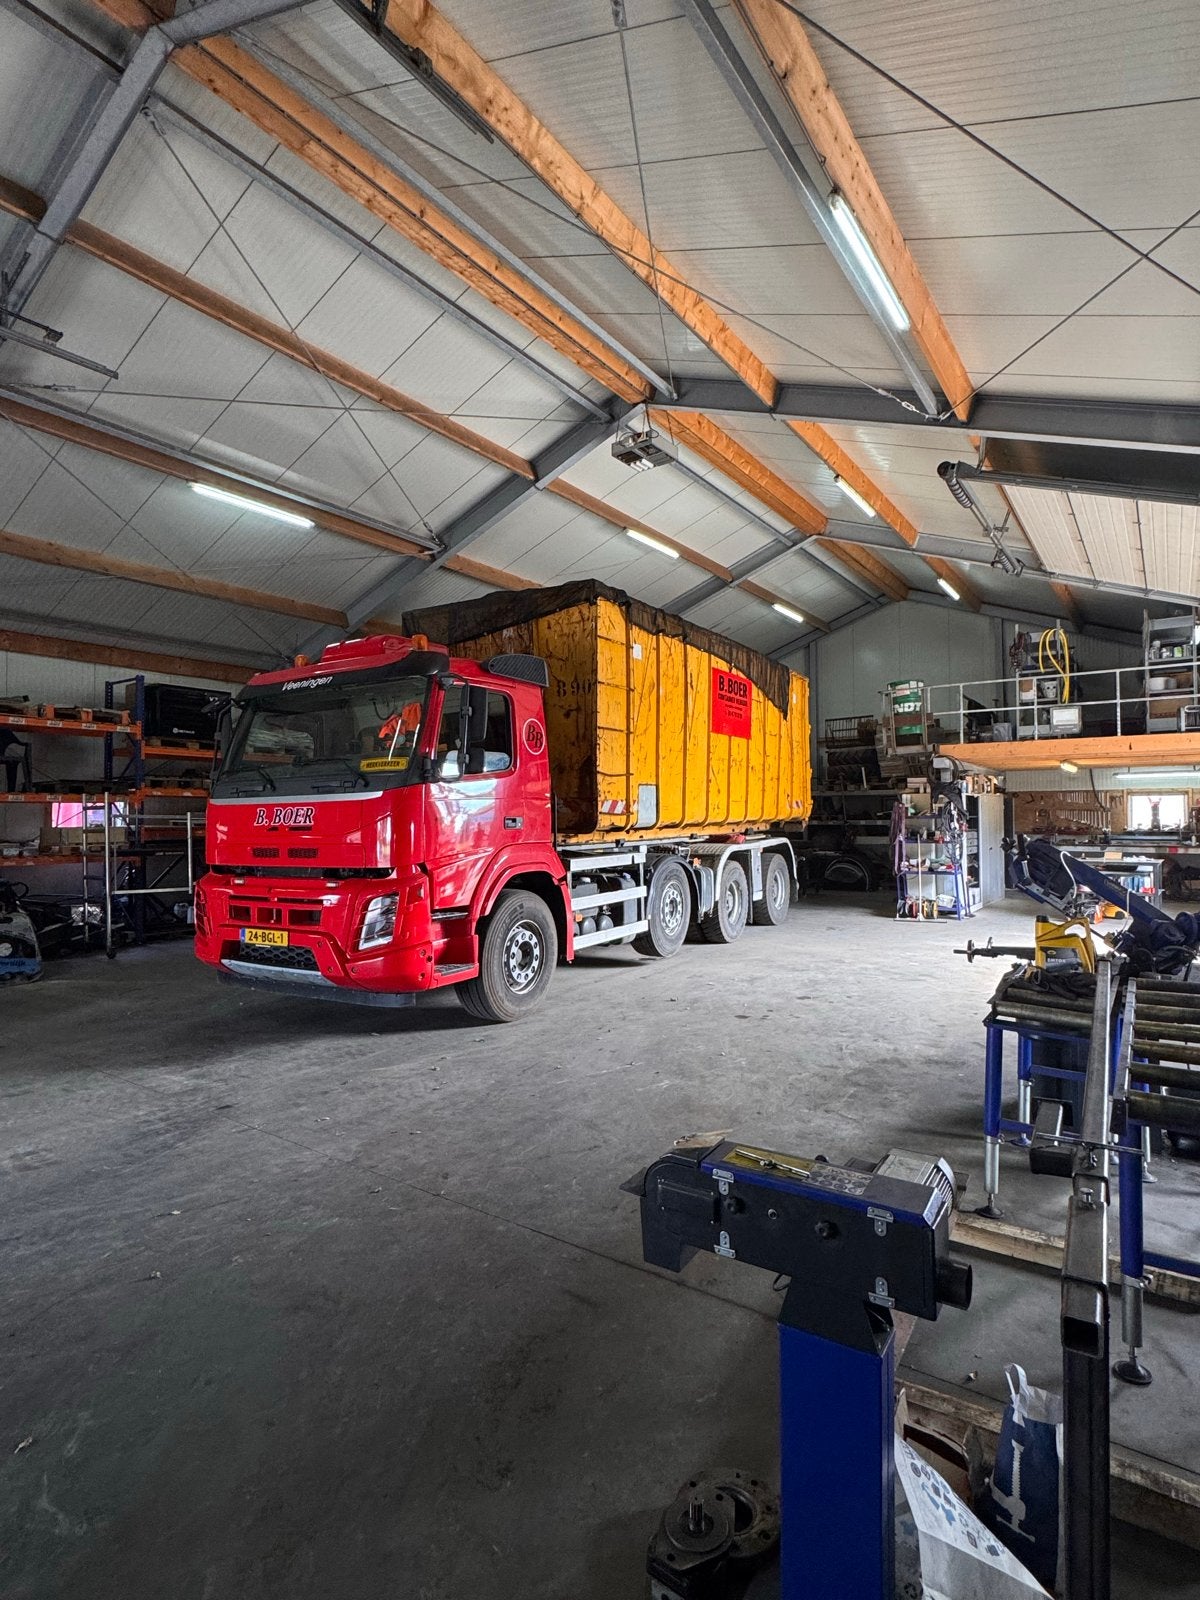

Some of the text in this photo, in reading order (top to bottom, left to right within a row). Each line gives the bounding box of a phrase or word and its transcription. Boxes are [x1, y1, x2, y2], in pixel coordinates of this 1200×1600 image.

[282, 676, 333, 691] Veeningen
[254, 806, 315, 826] B. BOER
[248, 930, 284, 944] 24-BGL-1
